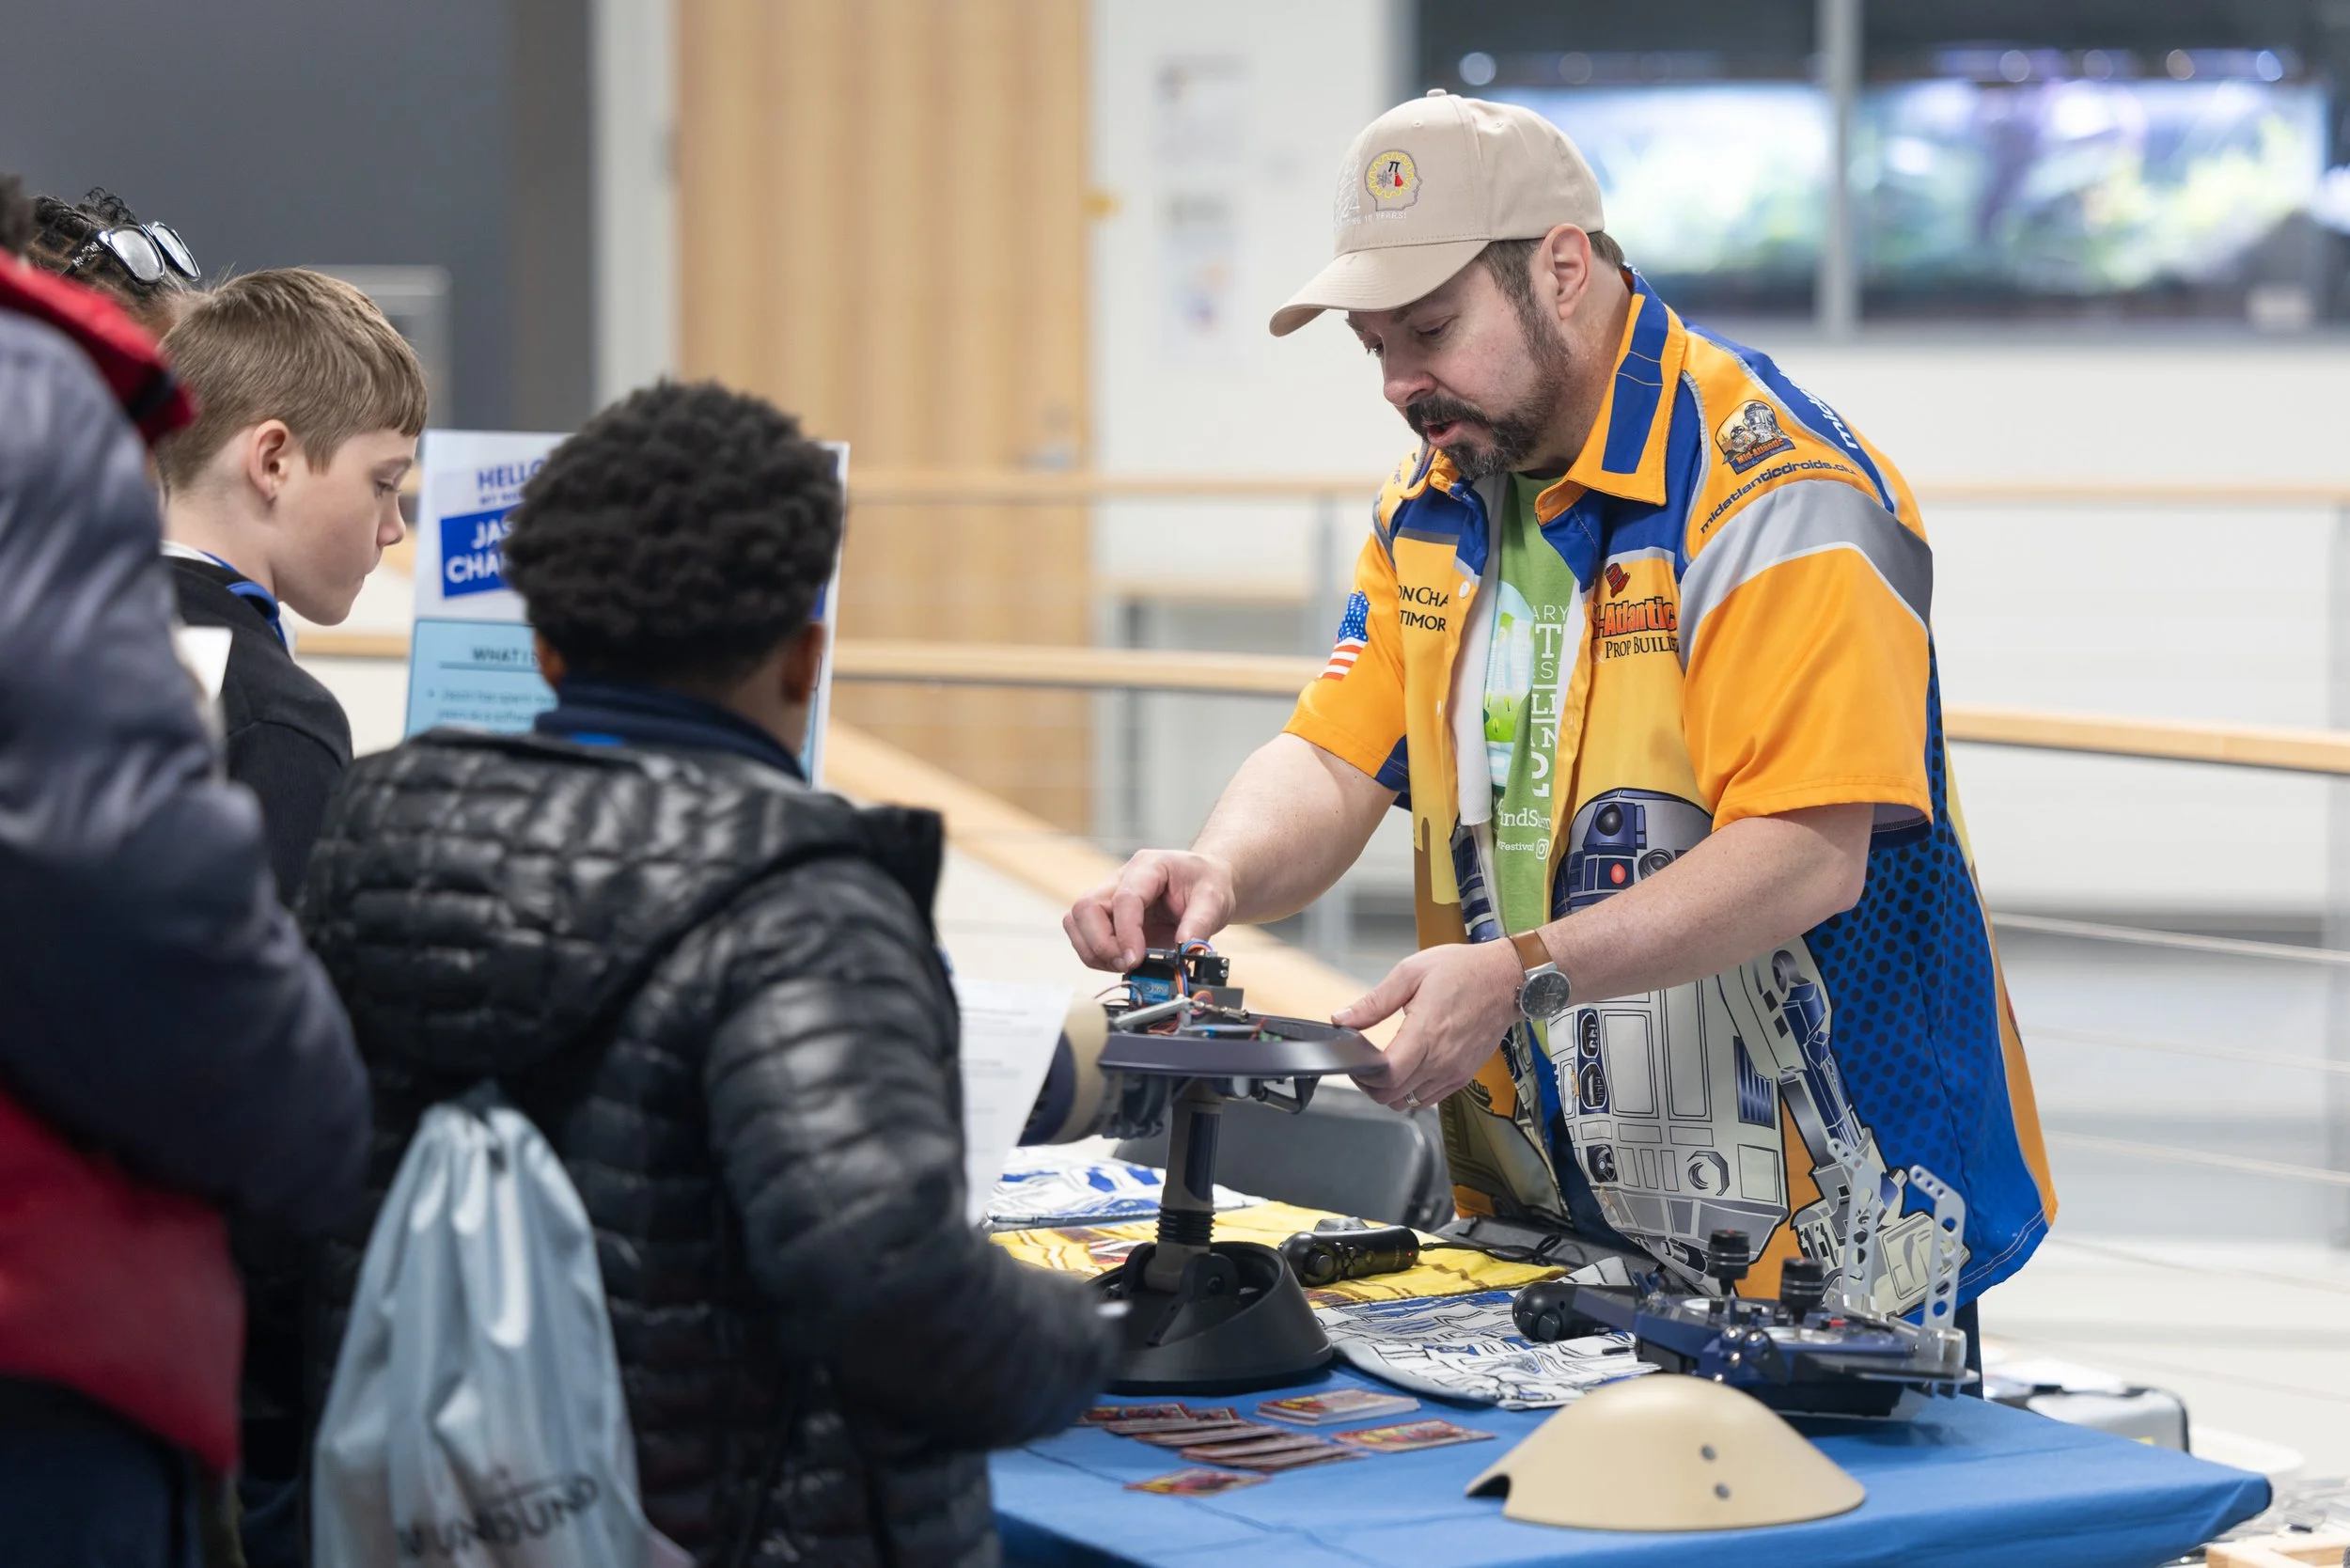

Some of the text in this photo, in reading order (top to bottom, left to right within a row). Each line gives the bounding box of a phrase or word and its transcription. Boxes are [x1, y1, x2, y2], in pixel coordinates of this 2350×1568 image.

[1400, 609, 1447, 633] TIMOR
[1592, 595, 1678, 640] -Atlantic
[1606, 640, 1631, 659] PROP
